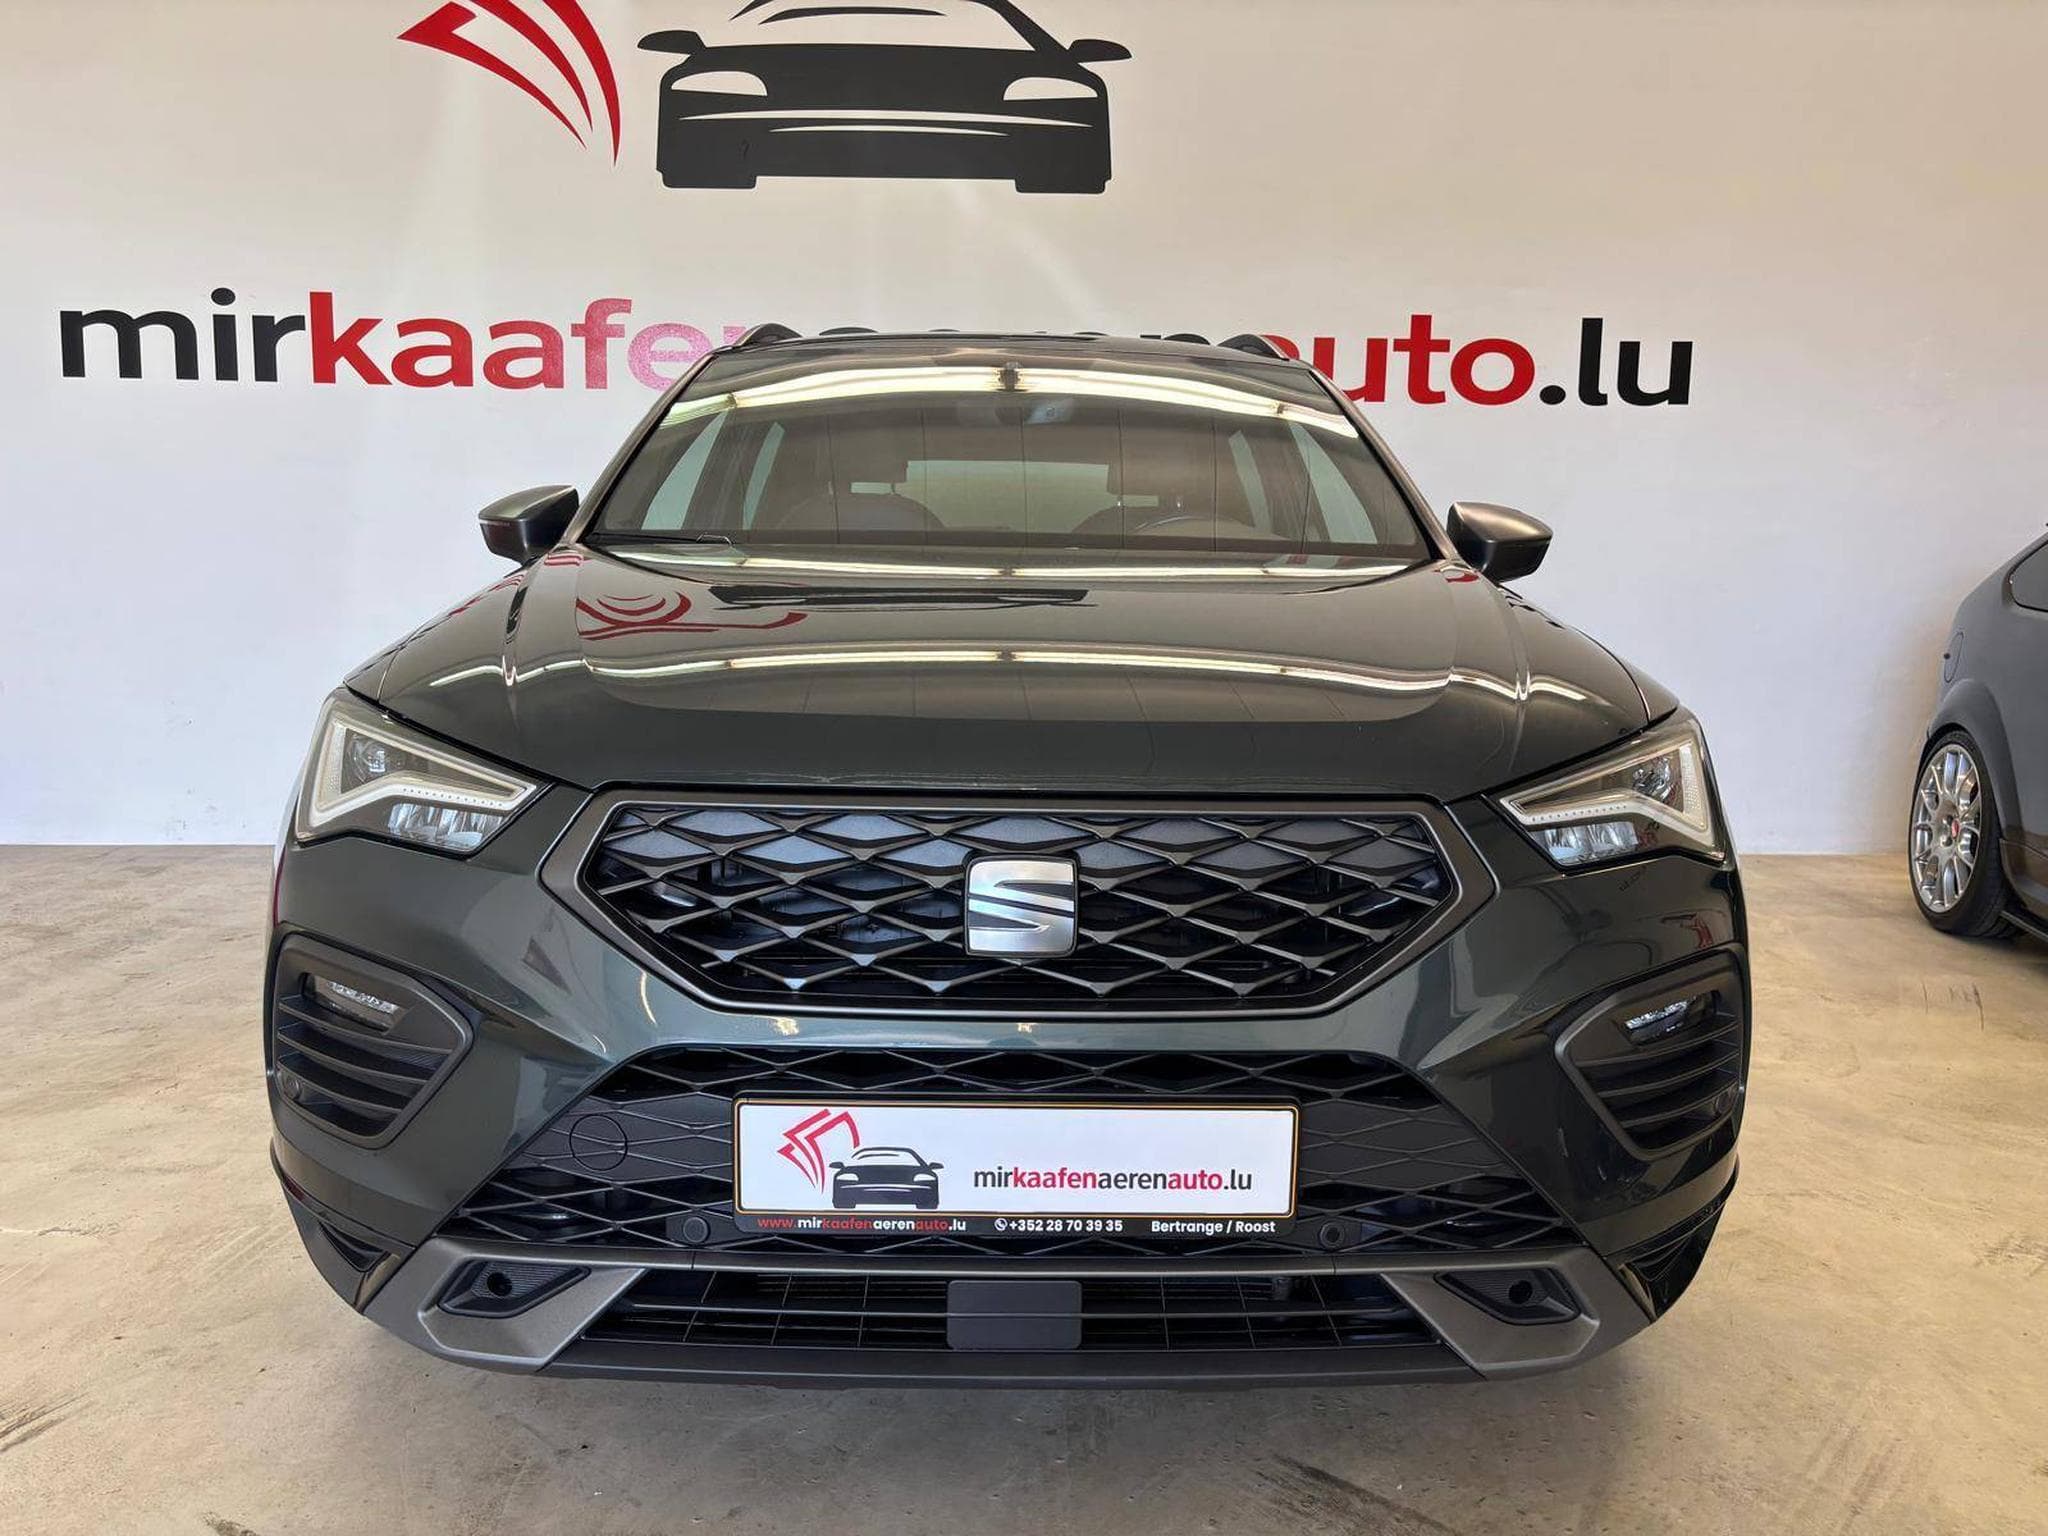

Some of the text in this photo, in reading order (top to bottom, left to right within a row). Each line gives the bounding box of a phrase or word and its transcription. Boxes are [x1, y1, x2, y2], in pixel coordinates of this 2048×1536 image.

[60, 287, 1694, 407] mirkaafeuto.lu
[973, 1166, 1253, 1191] mirkaafenaerenauto.lu
[757, 1216, 967, 1232] www.mirkaafenaerenauto.lu
[1009, 1219, 1123, 1232] +352 28 70 39 35
[1151, 1220, 1224, 1236] Bertrange
[1235, 1221, 1276, 1233] Roost
